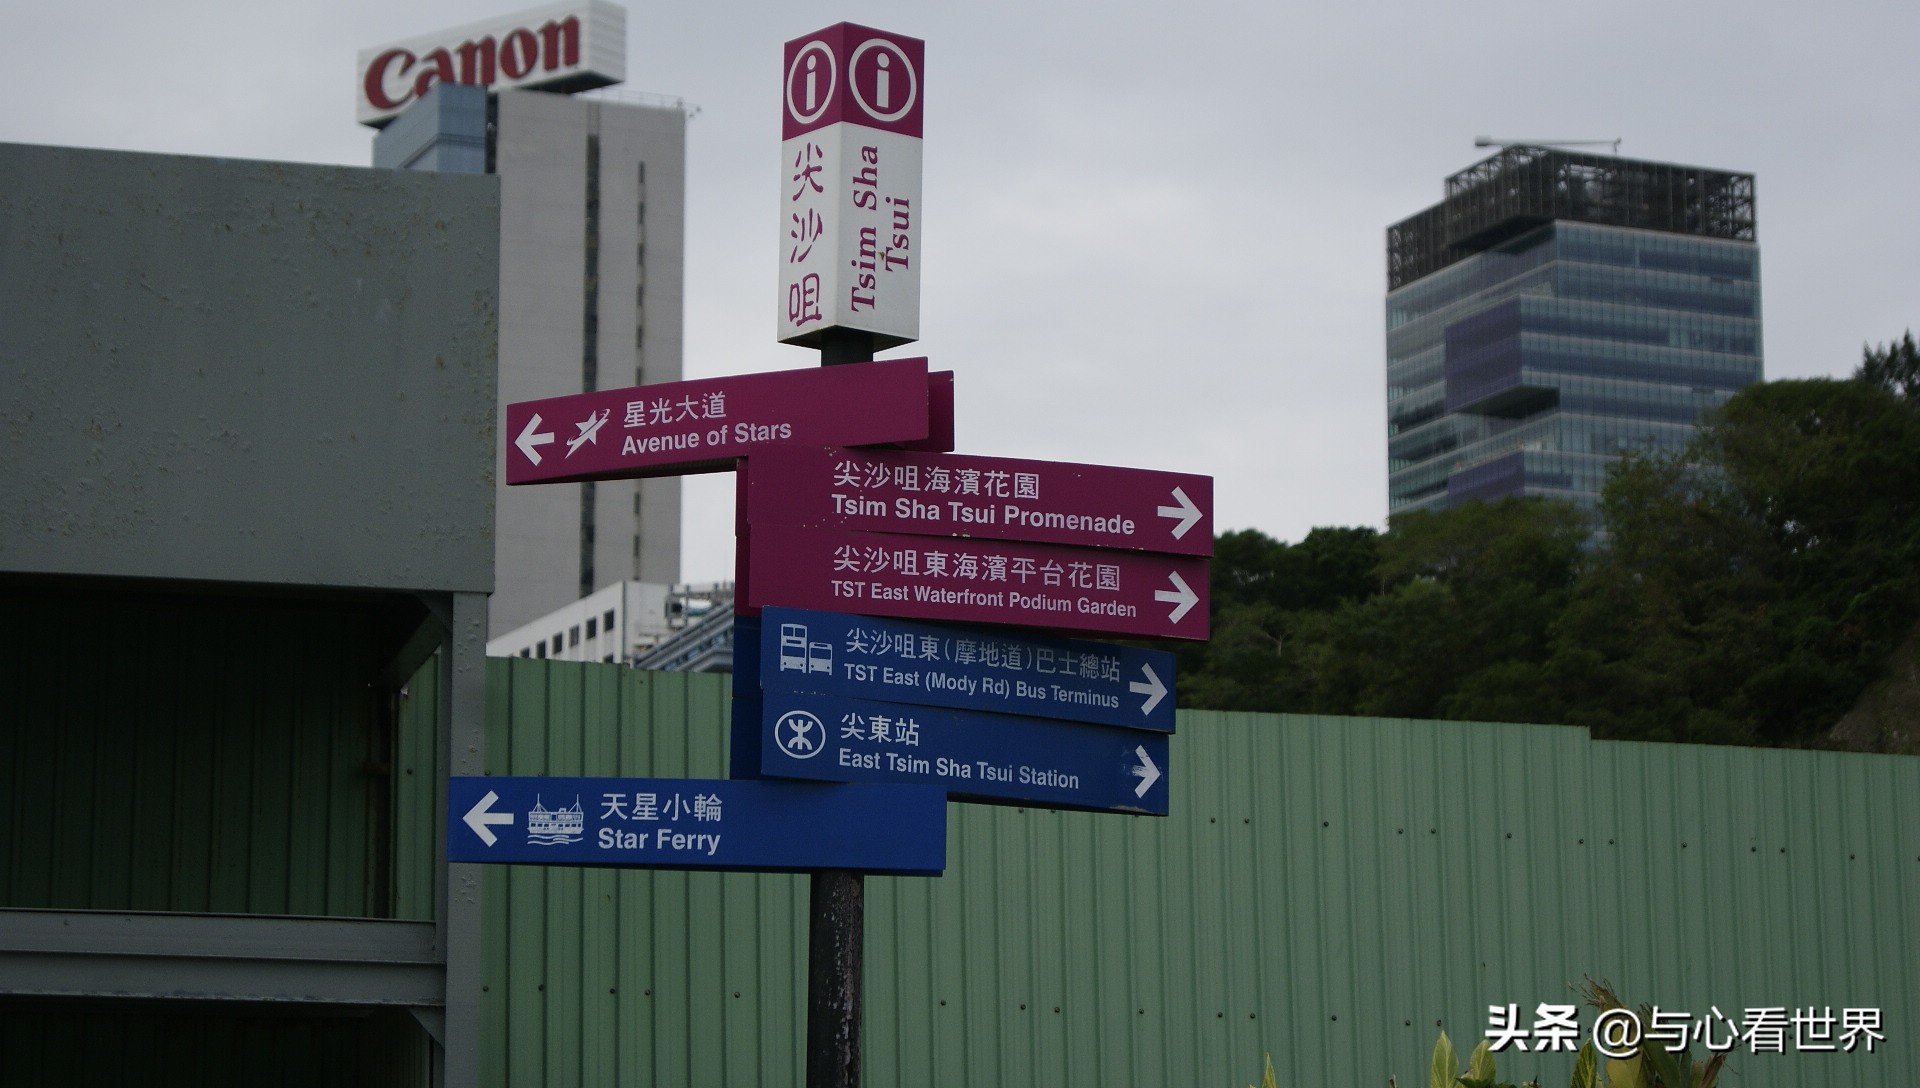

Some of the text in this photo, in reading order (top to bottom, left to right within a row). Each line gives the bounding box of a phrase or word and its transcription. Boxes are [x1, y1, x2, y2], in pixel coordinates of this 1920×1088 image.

[364, 14, 580, 110] Canon
[788, 142, 824, 326] 尖沙咀
[851, 145, 878, 312] Tsim Sha
[885, 196, 910, 272] Tsui
[623, 390, 727, 428] 星光大道
[621, 421, 792, 456] Avenue of Stars
[833, 459, 1040, 500] 尖沙咀海濱花園
[832, 493, 1136, 535] Tsim Sha Tsui Promenade
[833, 545, 1121, 592] 尖沙咀東海濱平台花園
[832, 580, 1137, 618] TST East Waterfront Podium Garden
[844, 663, 1120, 709] TST East (Mody Rd) Bus Terminus
[840, 712, 920, 747] 尖東站
[839, 748, 1080, 790] East Tsim Sha Tsui Station
[600, 792, 723, 823] 天星小輪
[598, 827, 722, 856] Star Ferry
